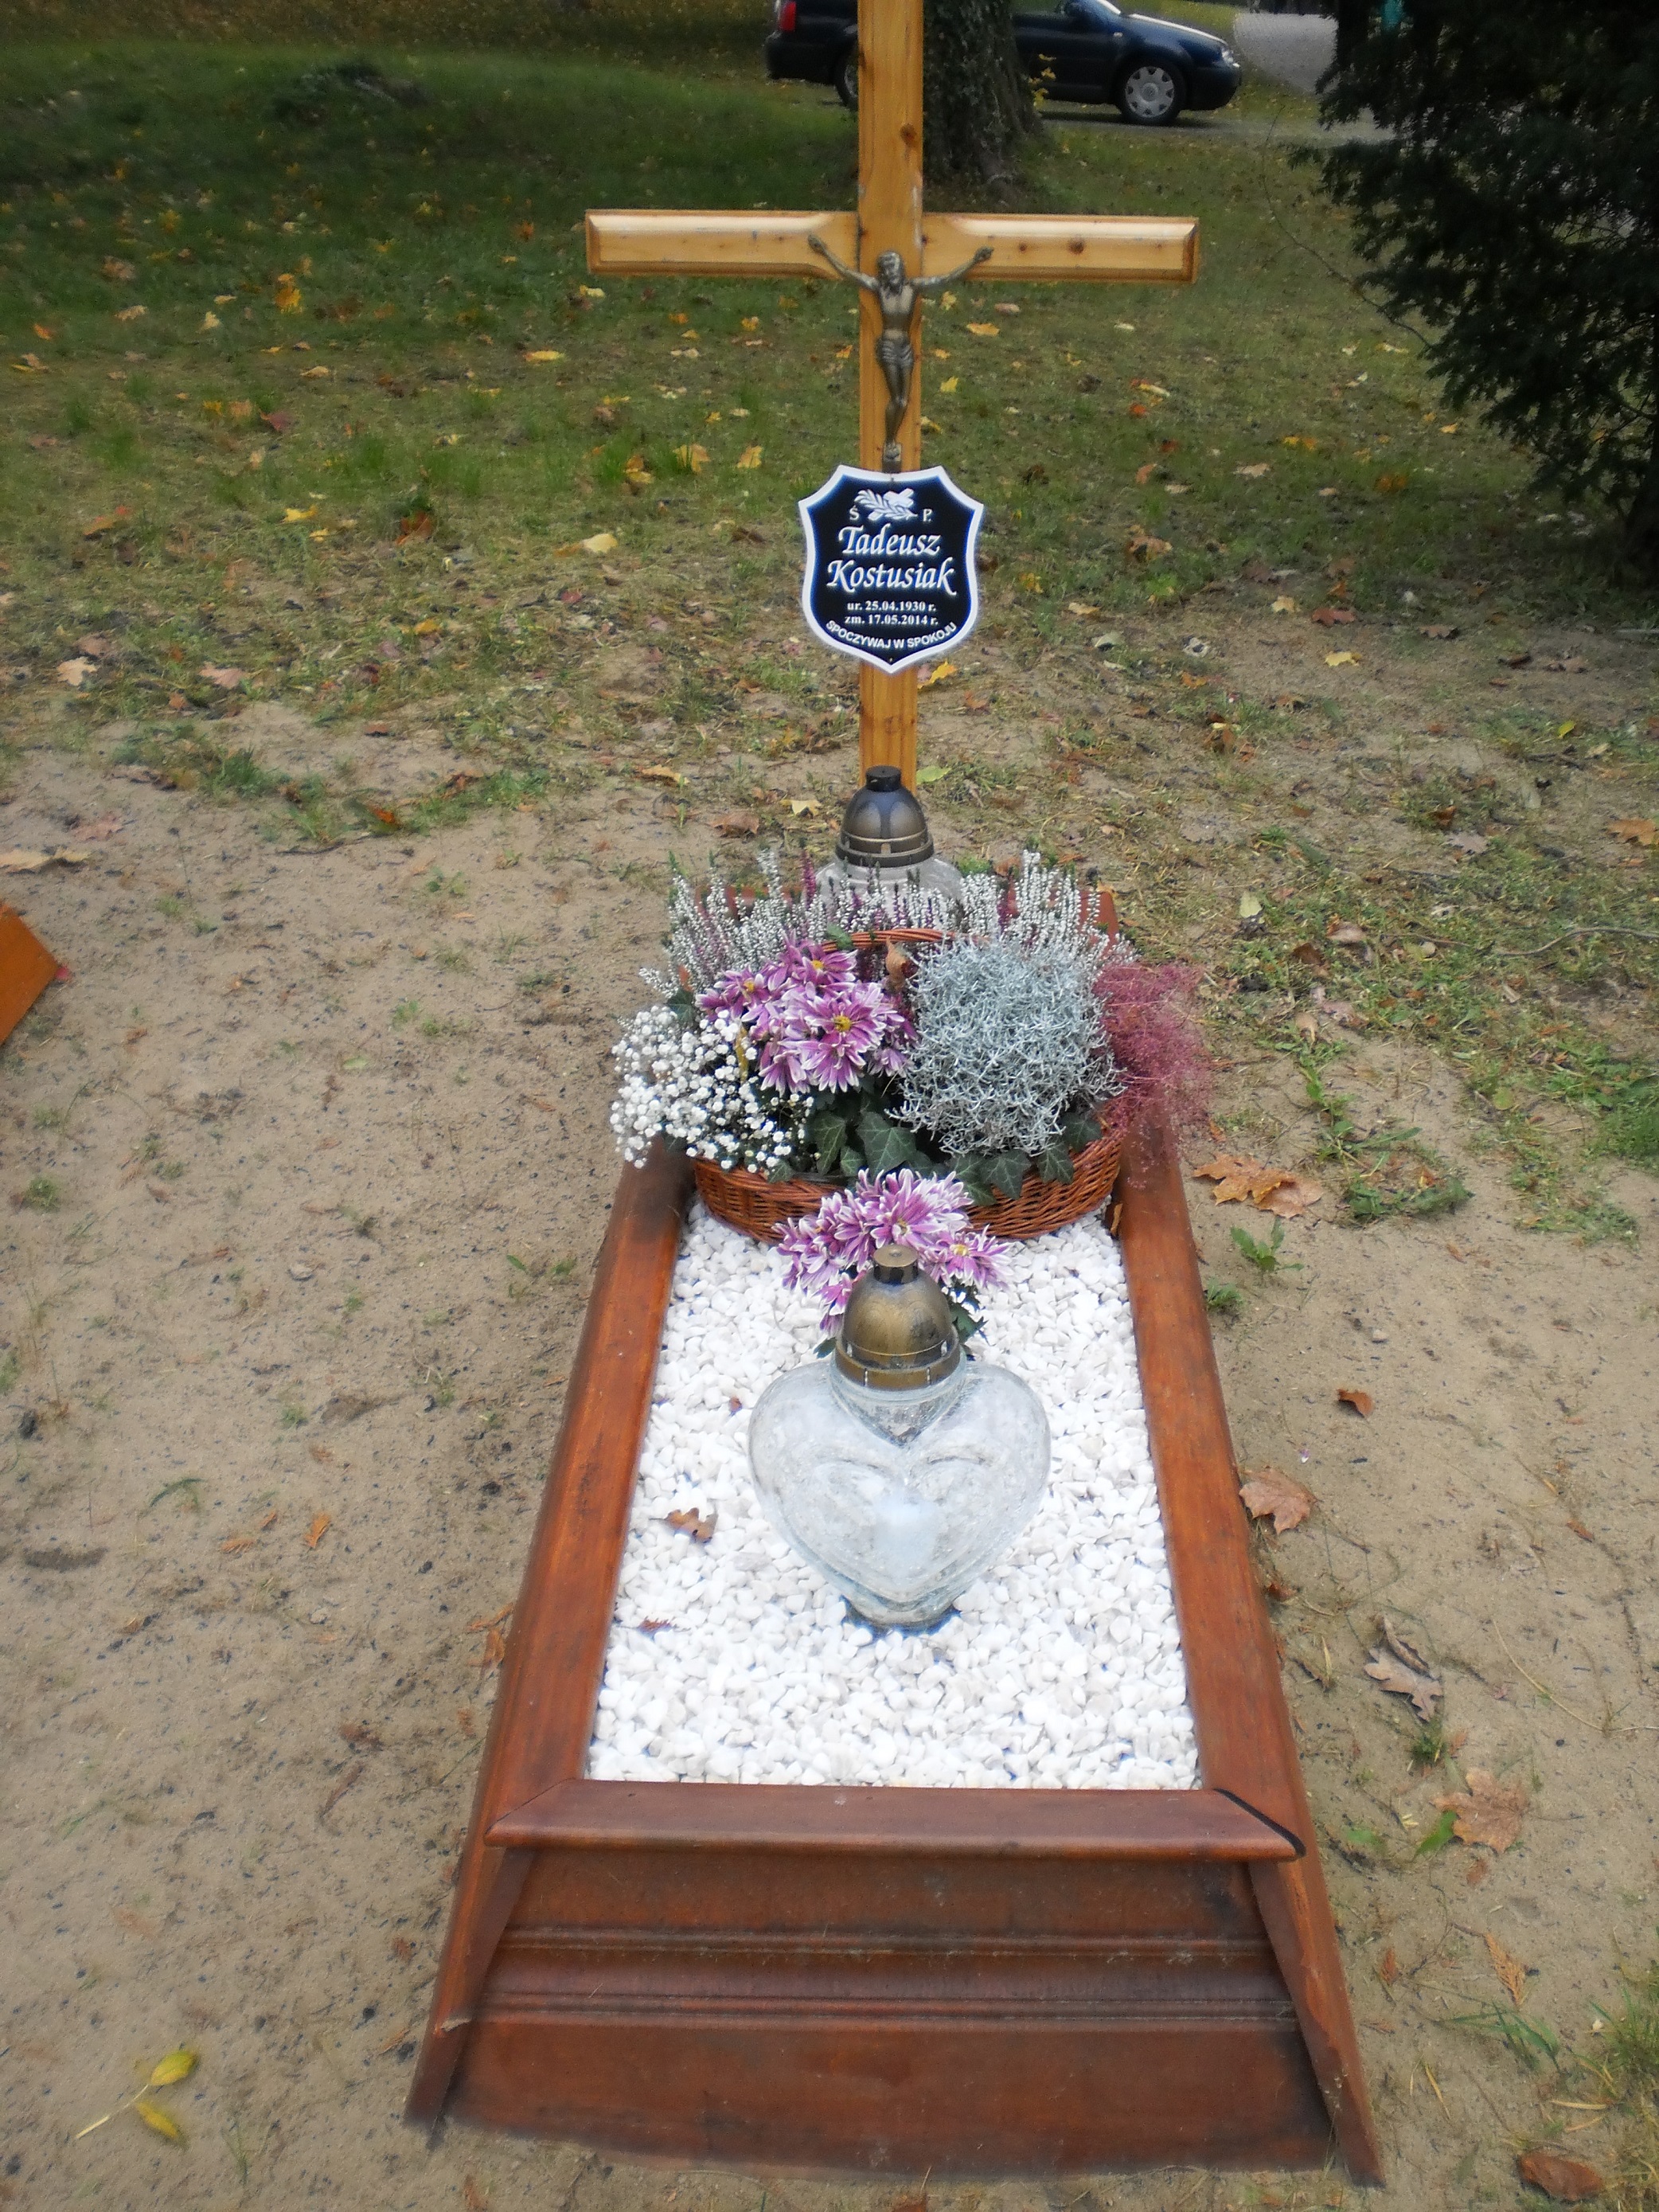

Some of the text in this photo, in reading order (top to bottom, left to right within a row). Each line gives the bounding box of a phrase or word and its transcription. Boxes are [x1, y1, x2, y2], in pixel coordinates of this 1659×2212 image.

[838, 522, 941, 555] Tadeusz
[826, 557, 957, 596] Kostusiak
[845, 614, 939, 625] zm. 17.05.2014 r.
[847, 600, 937, 612] ur. 25.04.1930 r.
[826, 619, 957, 649] SPOCZYWAJ W SPOKOJU
